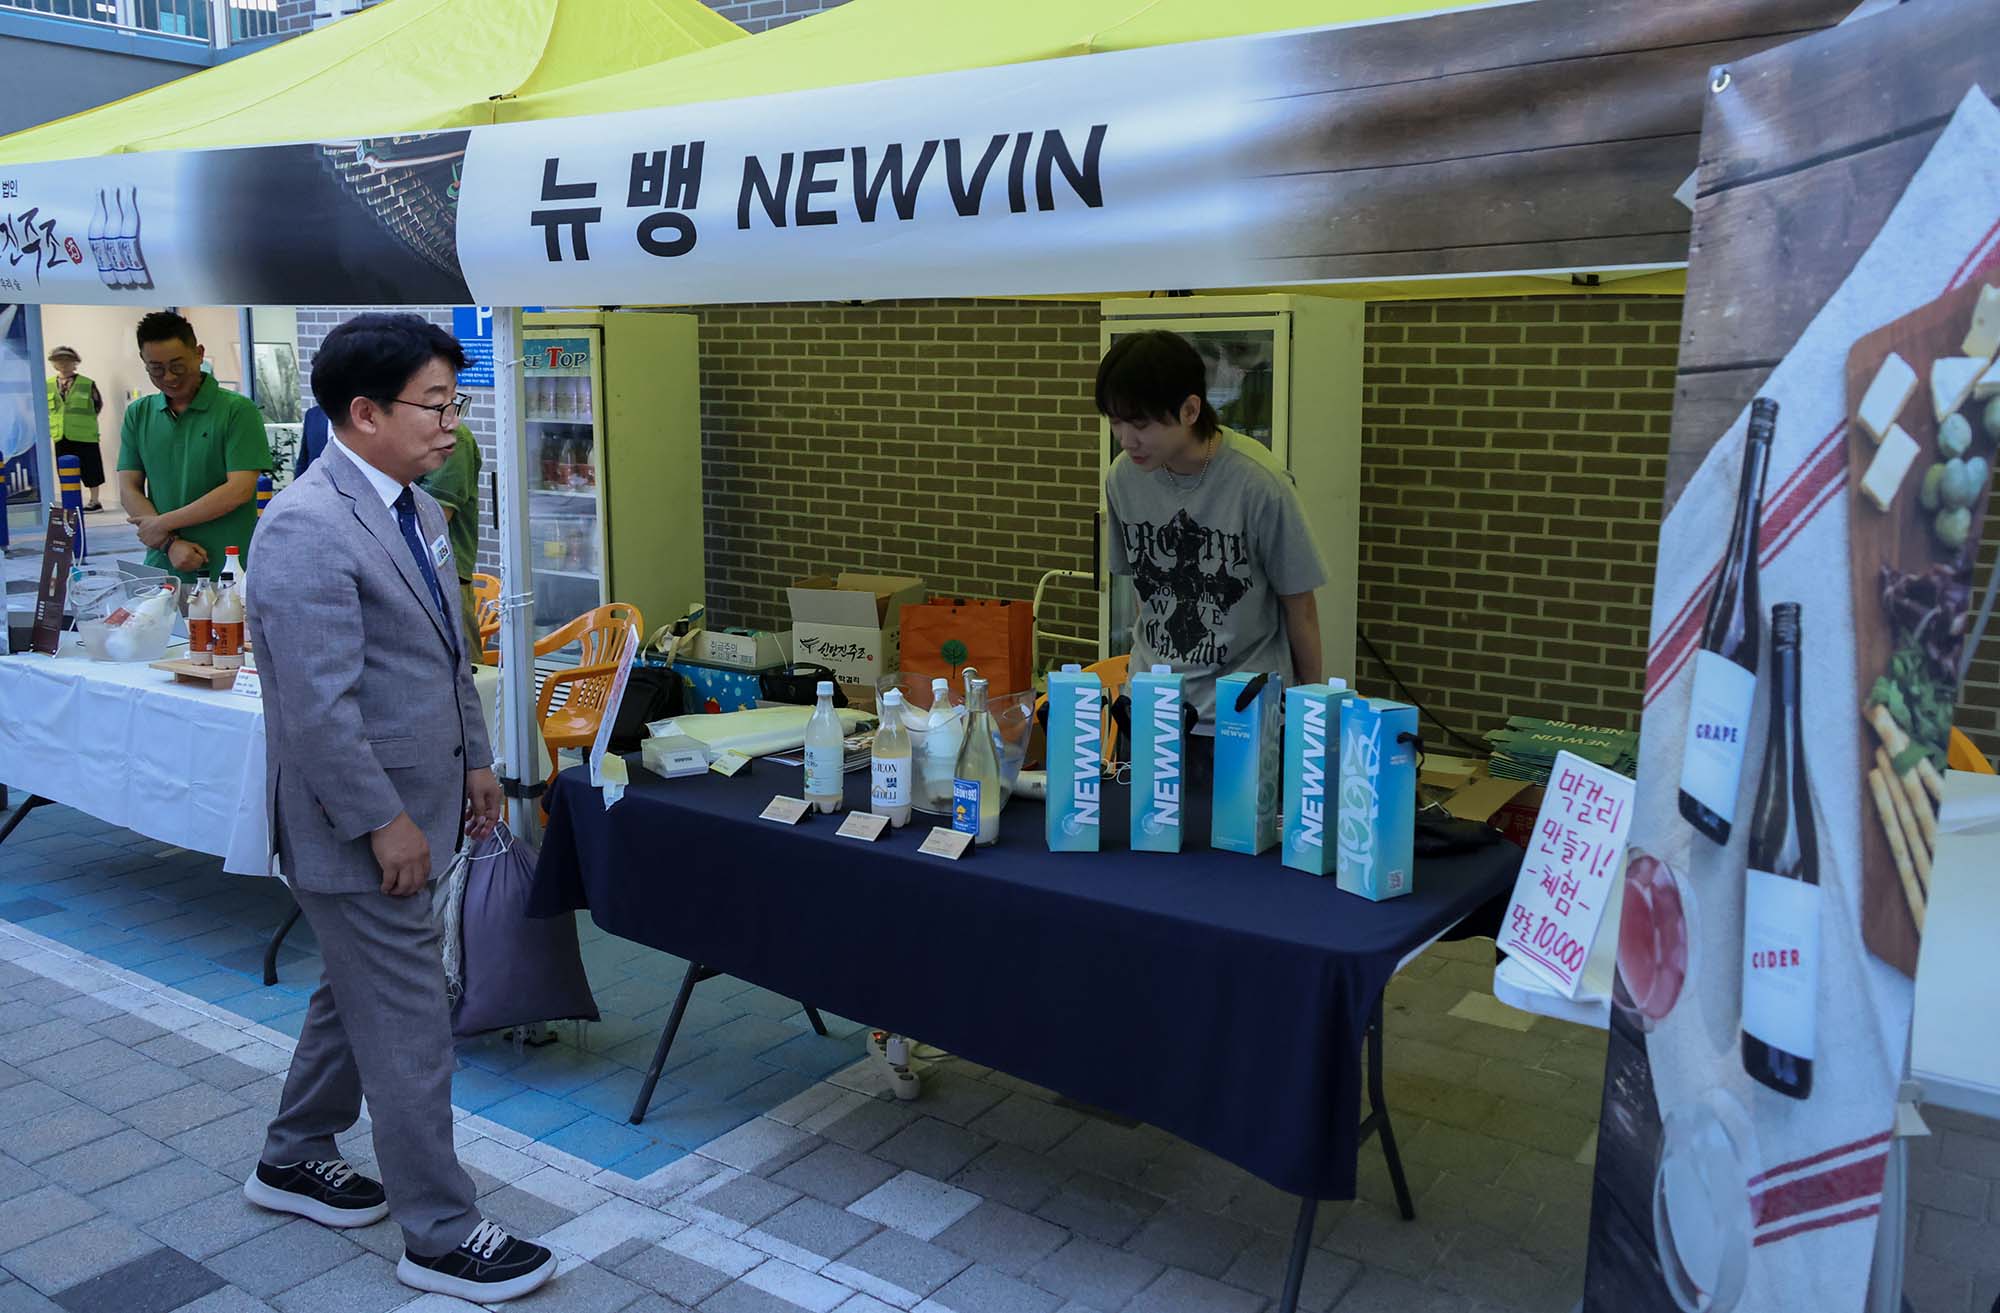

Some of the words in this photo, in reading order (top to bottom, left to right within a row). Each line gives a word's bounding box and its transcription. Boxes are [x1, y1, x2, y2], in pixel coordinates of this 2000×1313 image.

[737, 124, 1108, 230] NEWVIN
[545, 346, 587, 369] TOP
[1074, 687, 1100, 825] NEWVIN
[1154, 687, 1180, 826] NEWVIN
[1531, 734, 1611, 747] NEWVIN
[1545, 720, 1625, 735] NEWVIN
[1696, 723, 1738, 744] GRAPE
[1300, 698, 1326, 847] NEWVIN
[1559, 768, 1625, 833] 막걸리
[1541, 818, 1615, 879] 만들기!
[1532, 916, 1585, 972] 10,000
[1752, 948, 1801, 969] CIDER
